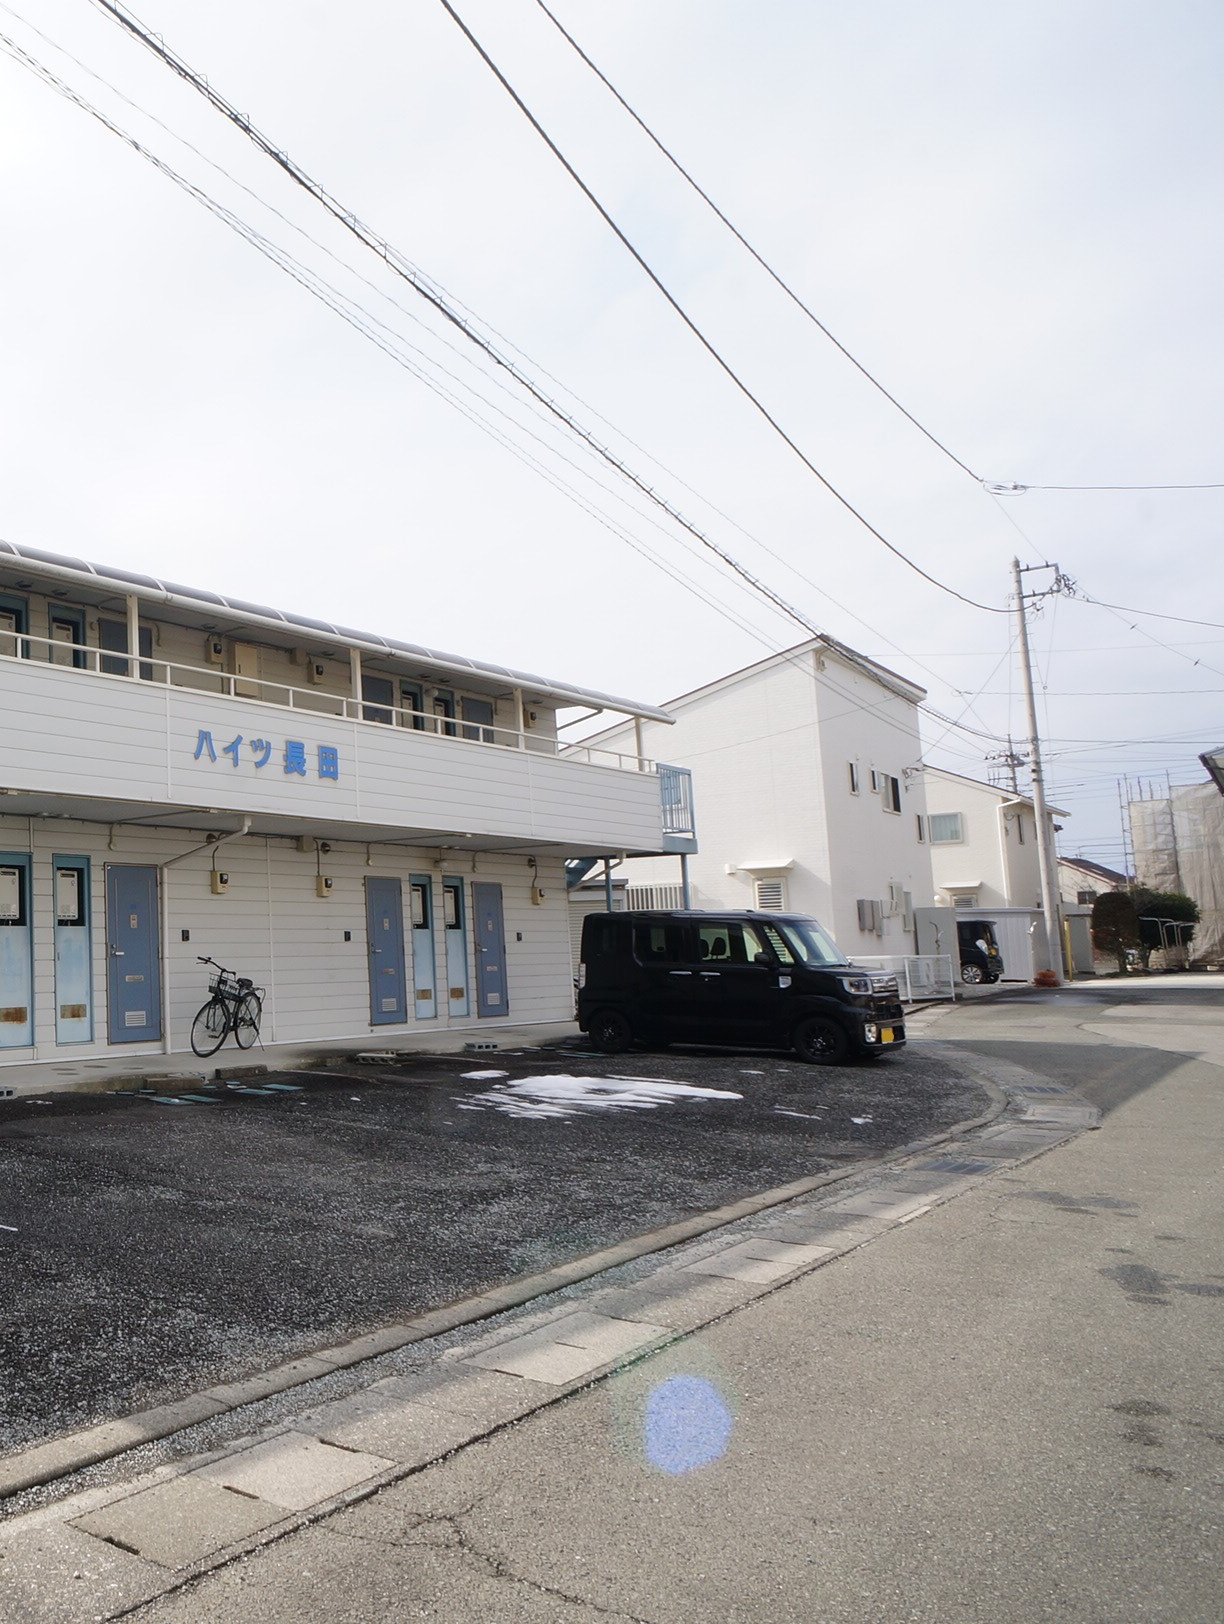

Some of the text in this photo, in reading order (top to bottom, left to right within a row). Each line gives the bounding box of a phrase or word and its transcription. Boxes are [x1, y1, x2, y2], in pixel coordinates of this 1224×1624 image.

[194, 729, 338, 780] ハイツ長田
